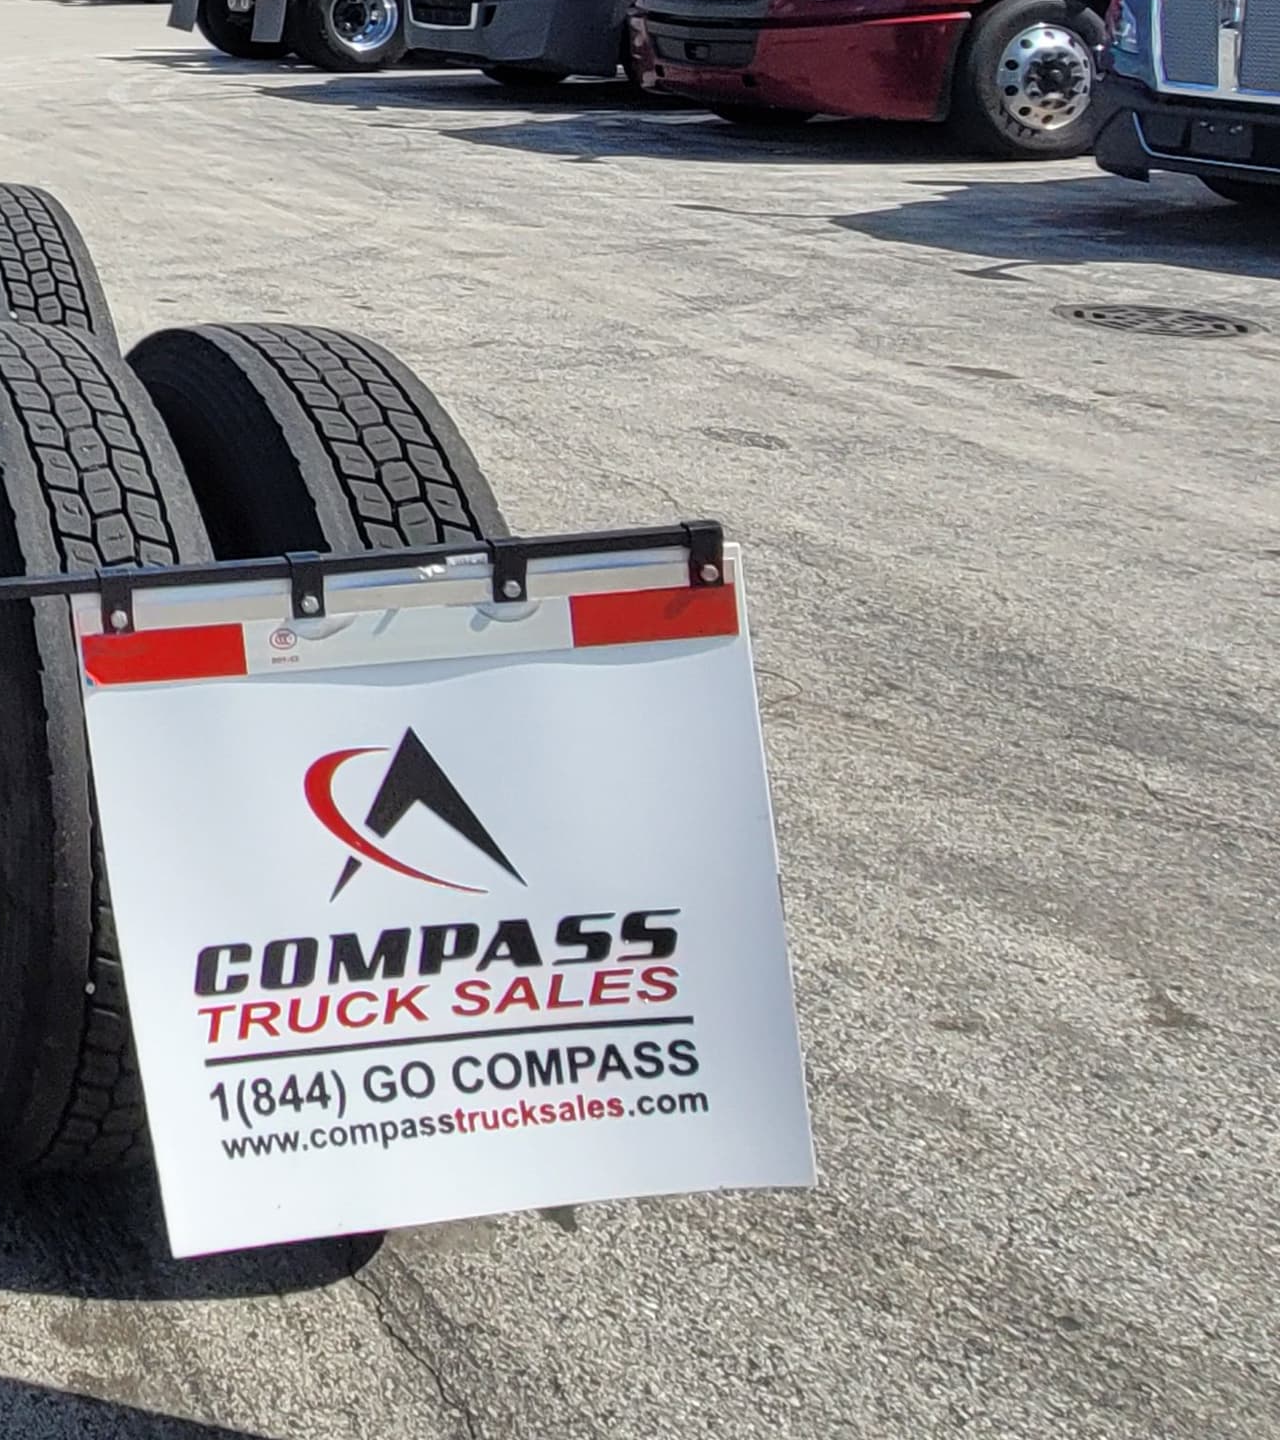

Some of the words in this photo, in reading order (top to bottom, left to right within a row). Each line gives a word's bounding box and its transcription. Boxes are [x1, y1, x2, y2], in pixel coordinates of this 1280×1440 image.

[194, 908, 680, 995] COMPASS
[198, 985, 430, 1043] TRUCK
[451, 966, 679, 1017] SALES
[209, 1069, 346, 1129] 1(844)
[363, 1060, 436, 1104] GO
[451, 1039, 700, 1095] COMPASS
[221, 1089, 709, 1160] www.compasstrucksales.com
